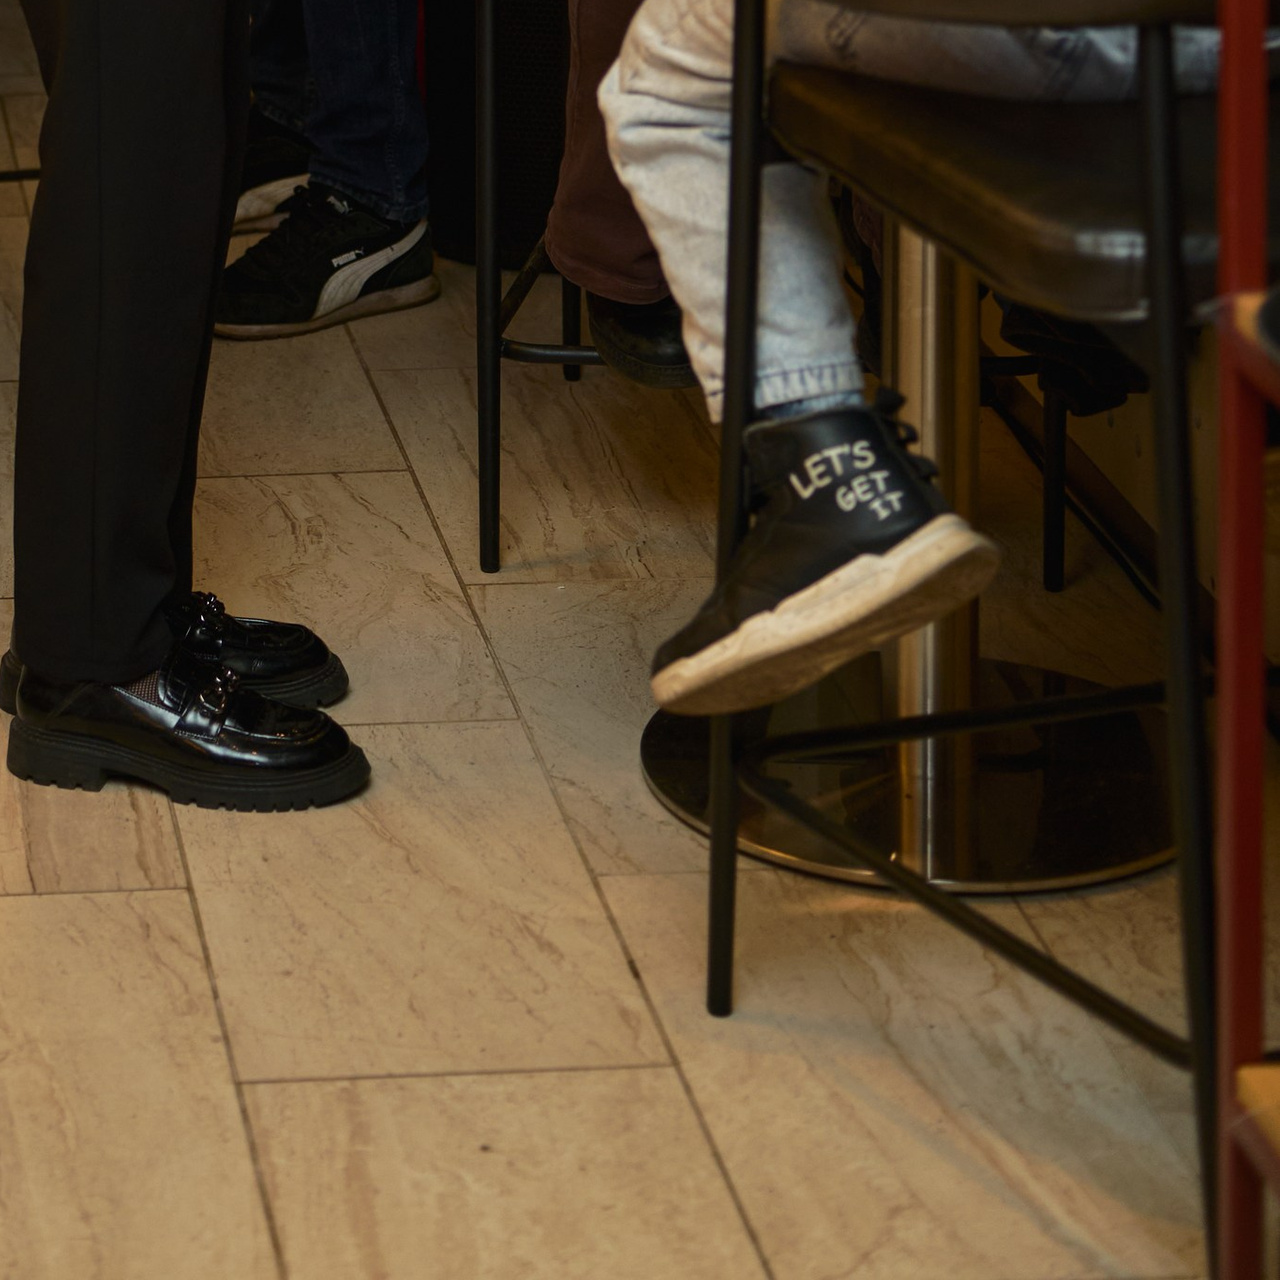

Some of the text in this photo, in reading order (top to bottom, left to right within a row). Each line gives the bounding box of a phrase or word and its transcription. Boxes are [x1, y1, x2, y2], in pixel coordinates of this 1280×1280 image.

[789, 439, 876, 500] LET'S
[835, 469, 890, 512] GET
[868, 490, 904, 521] IT
